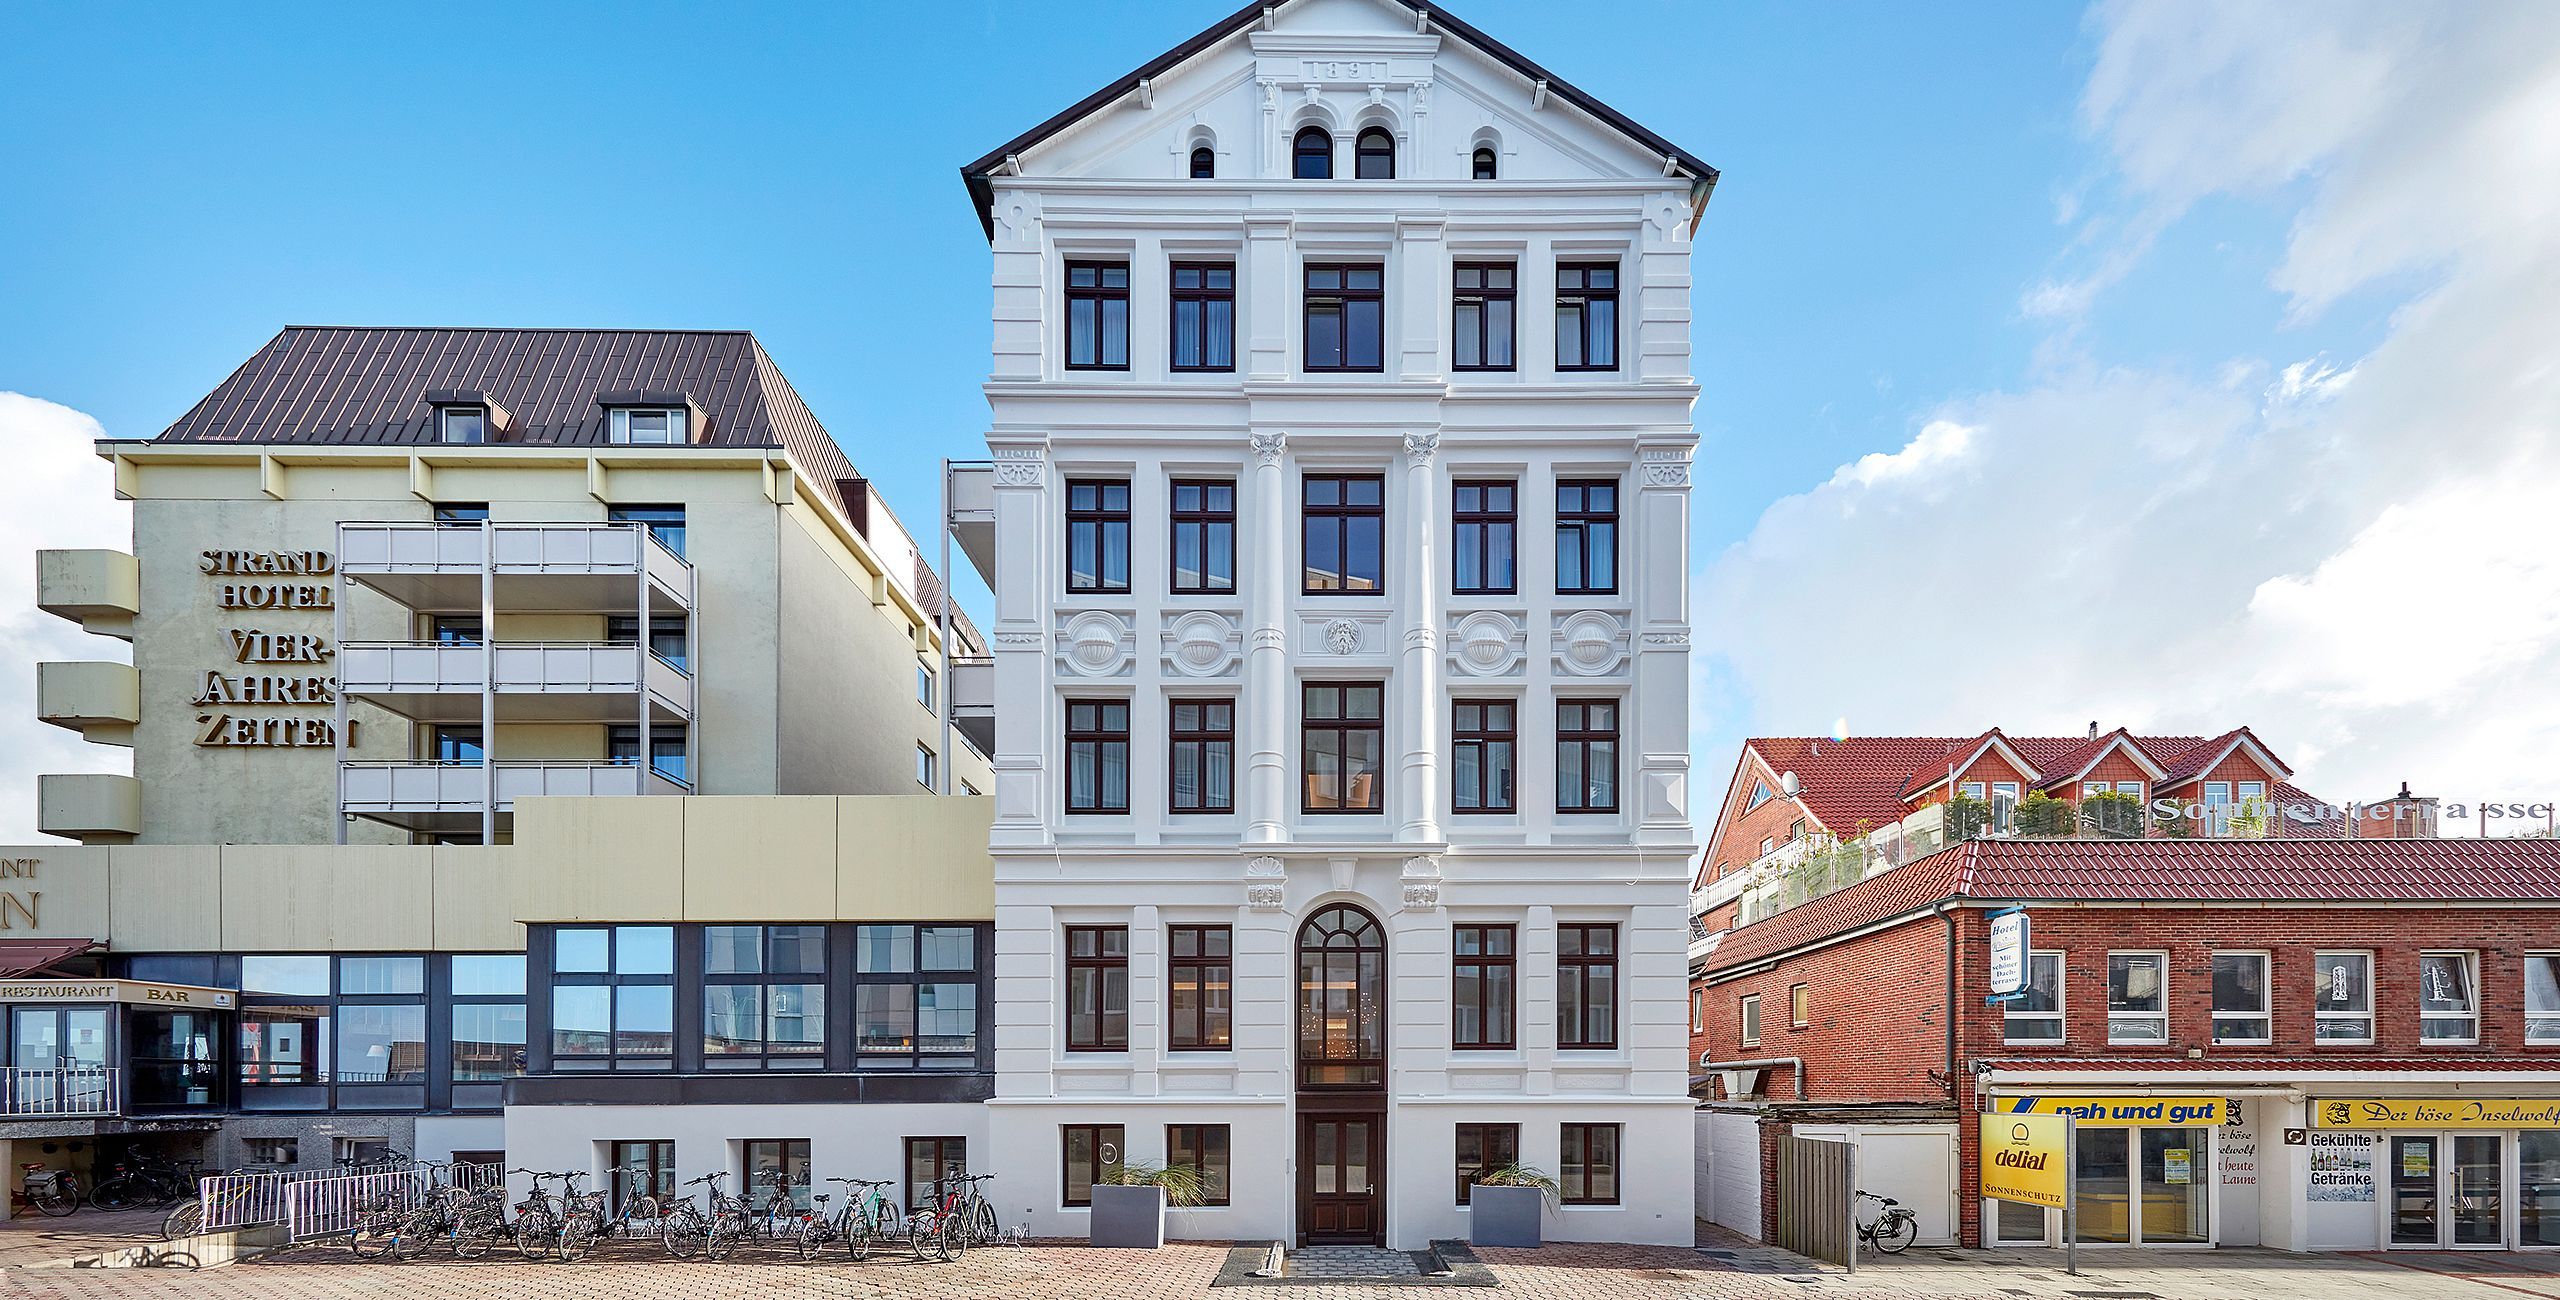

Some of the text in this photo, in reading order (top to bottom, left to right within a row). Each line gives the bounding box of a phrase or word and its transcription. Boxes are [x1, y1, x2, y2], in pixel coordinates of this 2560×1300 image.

[1312, 62, 1377, 79] 1891
[199, 550, 335, 576] STRAND
[217, 584, 335, 610] HOTEL
[217, 628, 335, 664] VIER-
[186, 670, 336, 707] JAHRES
[193, 712, 359, 748] ZEITEN
[1992, 921, 2018, 936] Hotel
[1992, 977, 2018, 985] terrasse
[1, 986, 114, 998] RESTAURANT
[147, 988, 190, 1002] BAR
[2056, 1103, 2215, 1123] nah und gut
[2362, 1102, 2560, 1125] Der böse Inselwolf
[2230, 1129, 2252, 1140] böse
[2311, 1134, 2371, 1146] Gekühlte
[2218, 1144, 2255, 1156] elwolf
[1995, 1149, 2048, 1170] delial
[2225, 1157, 2254, 1172] heute
[2222, 1174, 2257, 1185] Laune
[2311, 1172, 2371, 1185] Getränke
[1985, 1183, 2061, 1202] SONNENSCHUTZ
